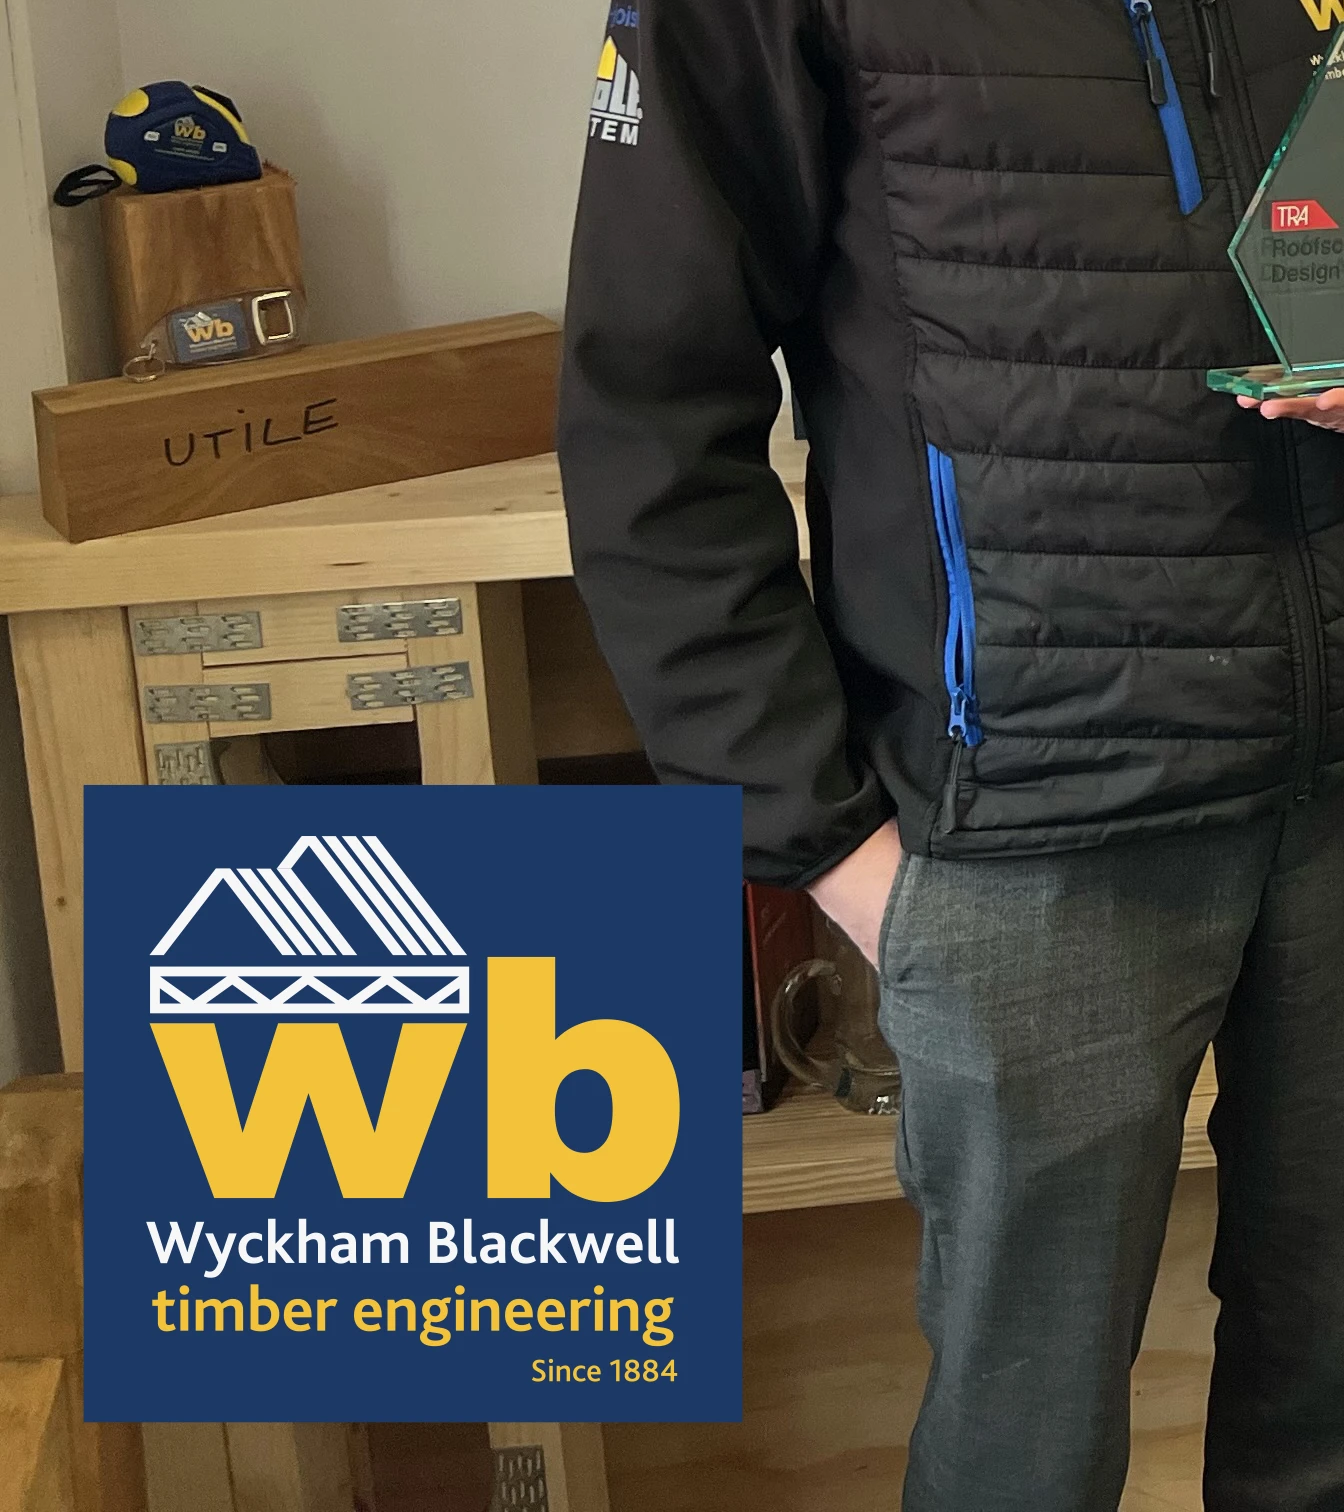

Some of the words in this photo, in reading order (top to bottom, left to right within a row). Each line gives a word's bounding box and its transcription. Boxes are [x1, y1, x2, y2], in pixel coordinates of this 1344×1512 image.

[1277, 205, 1309, 227] TRA
[1271, 263, 1340, 285] Design
[184, 318, 234, 343] wb
